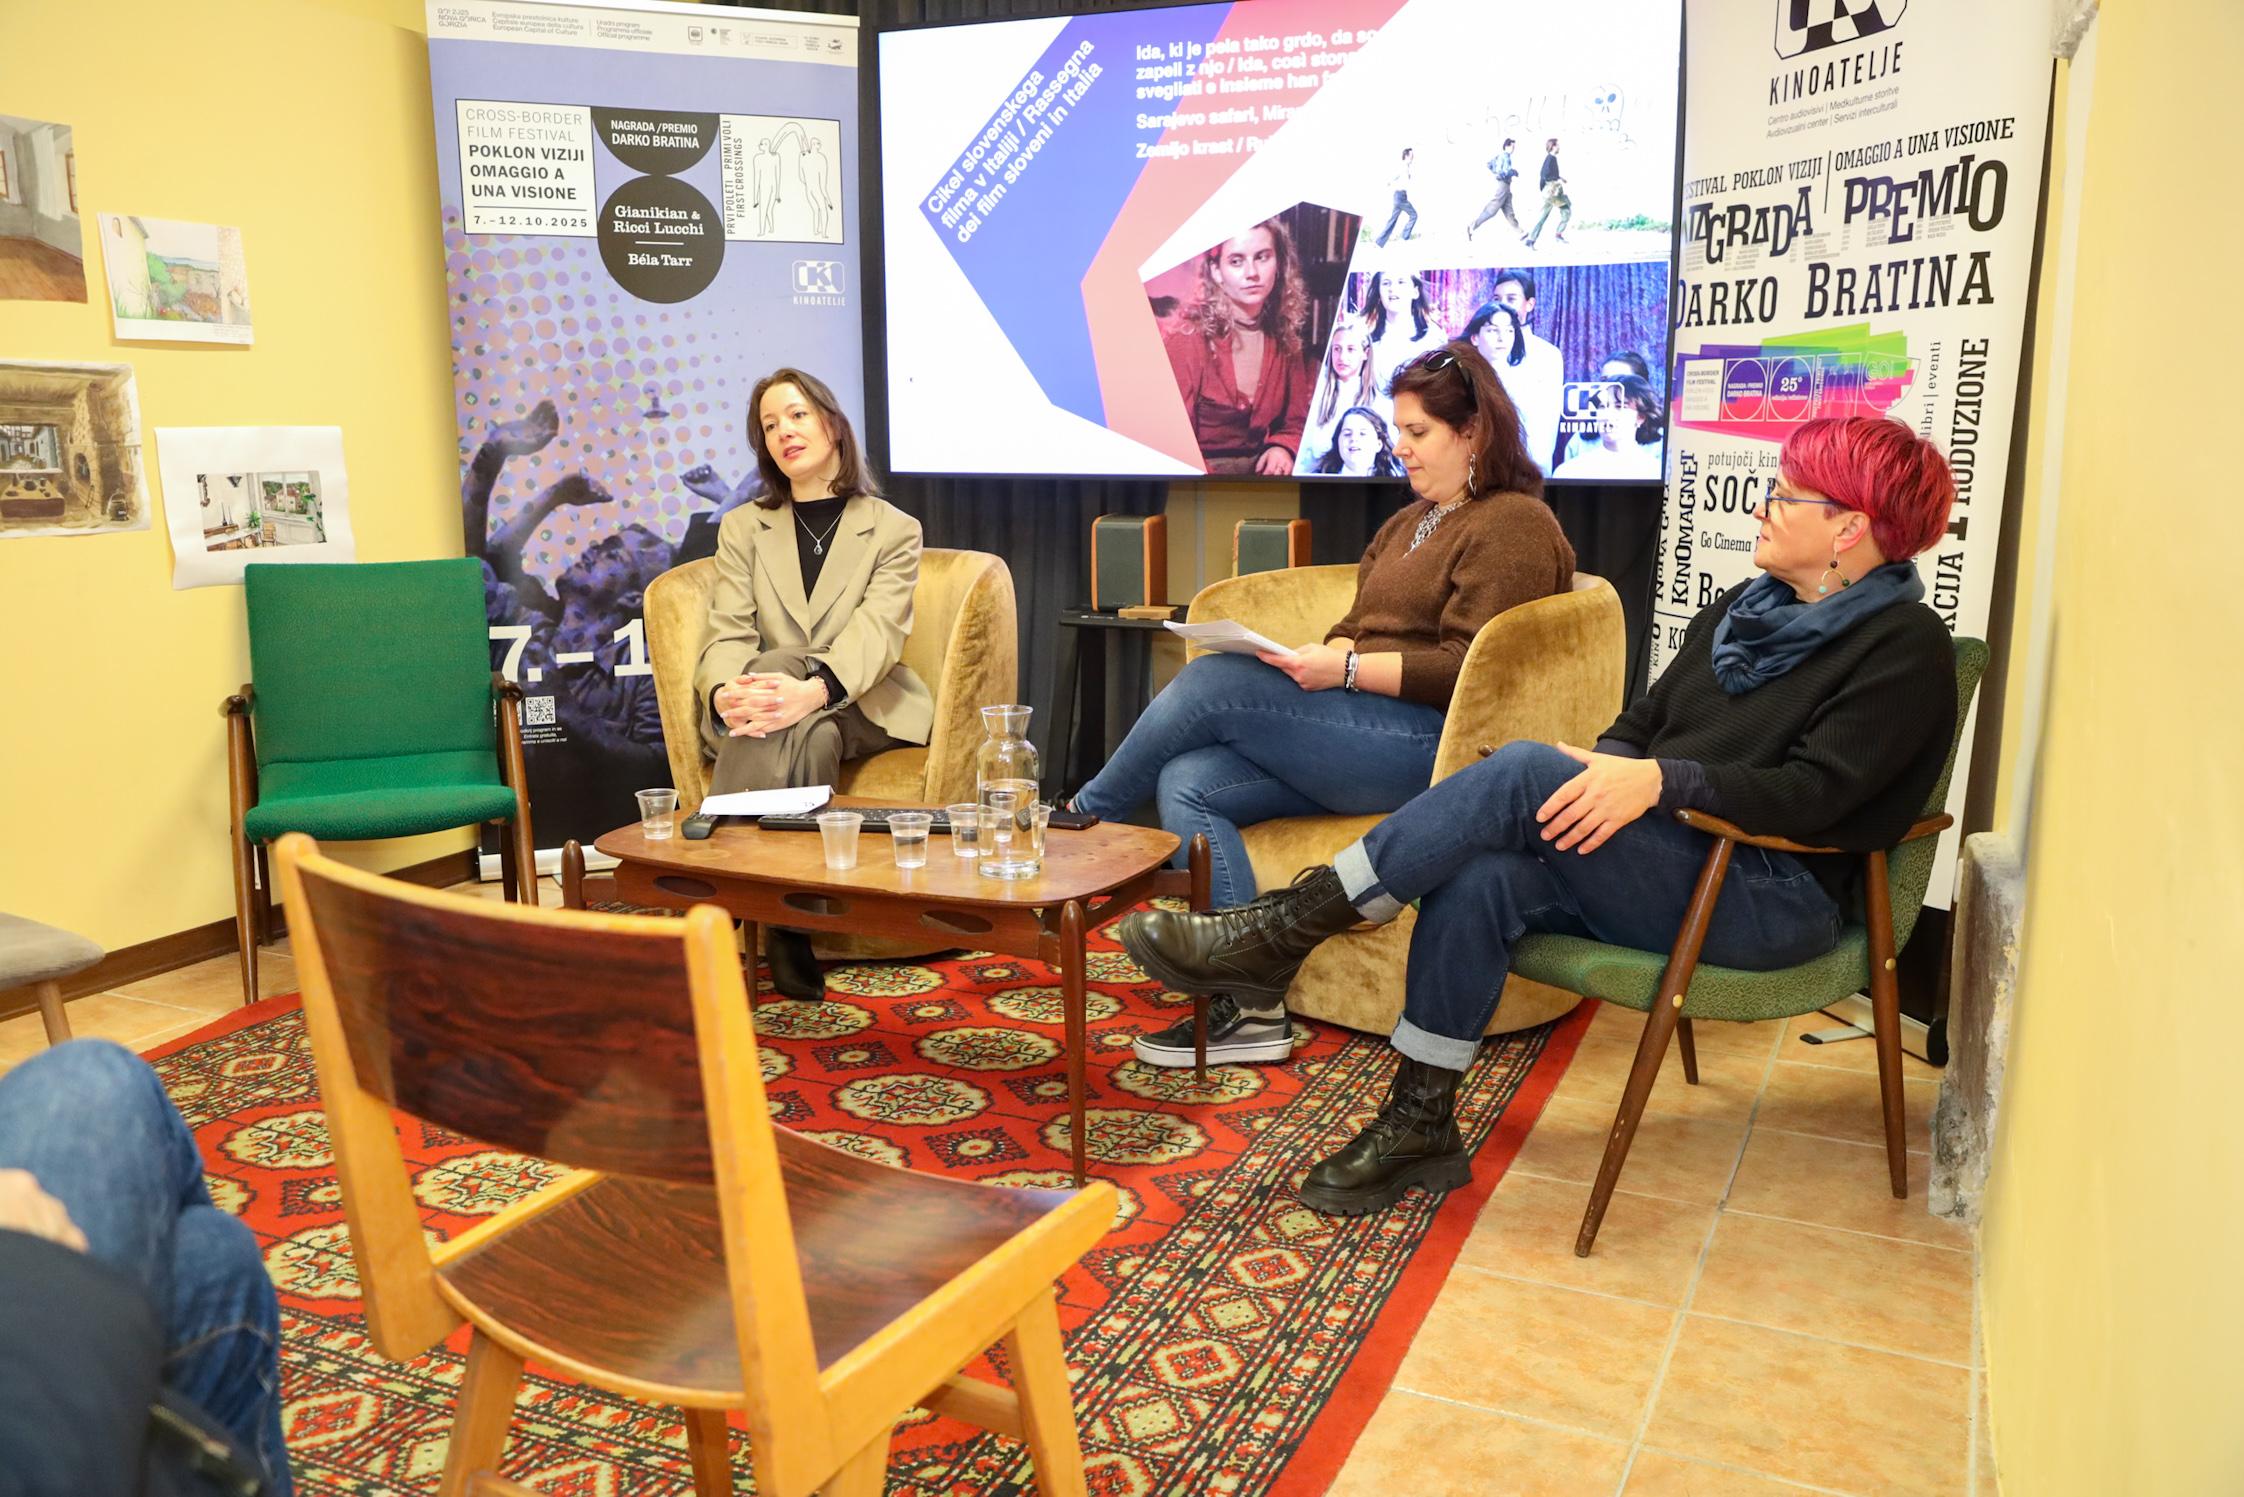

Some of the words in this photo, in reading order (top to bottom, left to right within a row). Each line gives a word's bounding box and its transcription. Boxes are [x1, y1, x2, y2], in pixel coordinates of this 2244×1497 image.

[1136, 45, 1165, 62] Ida,
[1169, 41, 1183, 58] ki
[1186, 41, 1202, 60] je
[1205, 37, 1240, 58] pela
[1243, 36, 1279, 53] tako
[1283, 32, 1327, 52] grdo,
[1330, 29, 1353, 45] da
[1135, 61, 1183, 82] zapeli
[1186, 63, 1196, 77] z
[1199, 59, 1225, 78] njo
[1238, 56, 1268, 74] Ida,
[1769, 41, 1903, 106] KINOATELJE
[1135, 79, 1202, 101] svegliati
[1206, 81, 1217, 95] e
[1220, 73, 1284, 93] insieme
[1287, 71, 1318, 89] han
[465, 108, 583, 125] CROSS-BORDER
[611, 119, 655, 133] NAGRADA
[1136, 110, 1206, 130] Sarajevo
[1208, 106, 1259, 125] safari,
[1767, 113, 1790, 126] Centro
[1807, 118, 1829, 130] center
[1833, 111, 1857, 124] Servizi
[467, 125, 502, 138] FILM
[508, 127, 575, 142] FESTIVAL
[612, 133, 650, 147] DARKO
[652, 135, 700, 149] BRATINA
[722, 120, 731, 140] VOLI
[928, 169, 965, 213] Cikel
[962, 70, 1045, 173] slovenskega
[941, 187, 979, 229] filma
[973, 174, 987, 188] v
[982, 130, 1020, 176] Italiji
[1022, 40, 1095, 124] Rassegna
[976, 183, 1008, 216] film
[1003, 121, 1054, 184] sloveni
[1047, 105, 1068, 126] in
[1062, 63, 1103, 107] Italia
[469, 144, 536, 160] POKLON
[541, 147, 585, 162] VIZIJI
[723, 144, 733, 170] PRIMI
[733, 137, 744, 191] CROSSINGS
[1733, 165, 1783, 191] POKLON
[1788, 157, 1823, 181] VIZIJI
[1835, 141, 1891, 172] OMAGGIO
[1893, 138, 1903, 159] A
[1907, 130, 1939, 156] UNA
[1944, 117, 2015, 148] VISIONE
[470, 164, 549, 180] OMAGGIO
[554, 168, 565, 180] A
[471, 184, 506, 198] UNA
[511, 186, 577, 200] VISIONE
[725, 180, 735, 209] POLETI
[1844, 154, 2009, 245] PREMIO
[614, 205, 688, 220] Gianikian
[691, 210, 701, 220] &
[736, 193, 745, 218] FIRST
[613, 220, 651, 234] Ricci
[654, 221, 704, 235] Lucchi
[726, 214, 736, 234] PRVI
[628, 253, 659, 266] Béla
[660, 254, 693, 267] Tarr
[1804, 251, 1995, 319] BRATINA
[1928, 340, 1941, 390] eventi
[1708, 450, 1753, 472] potujoči
[1671, 449, 1698, 607] KINOMAGNET
[1701, 531, 1712, 548] Go
[1714, 532, 1751, 553] Cinema
